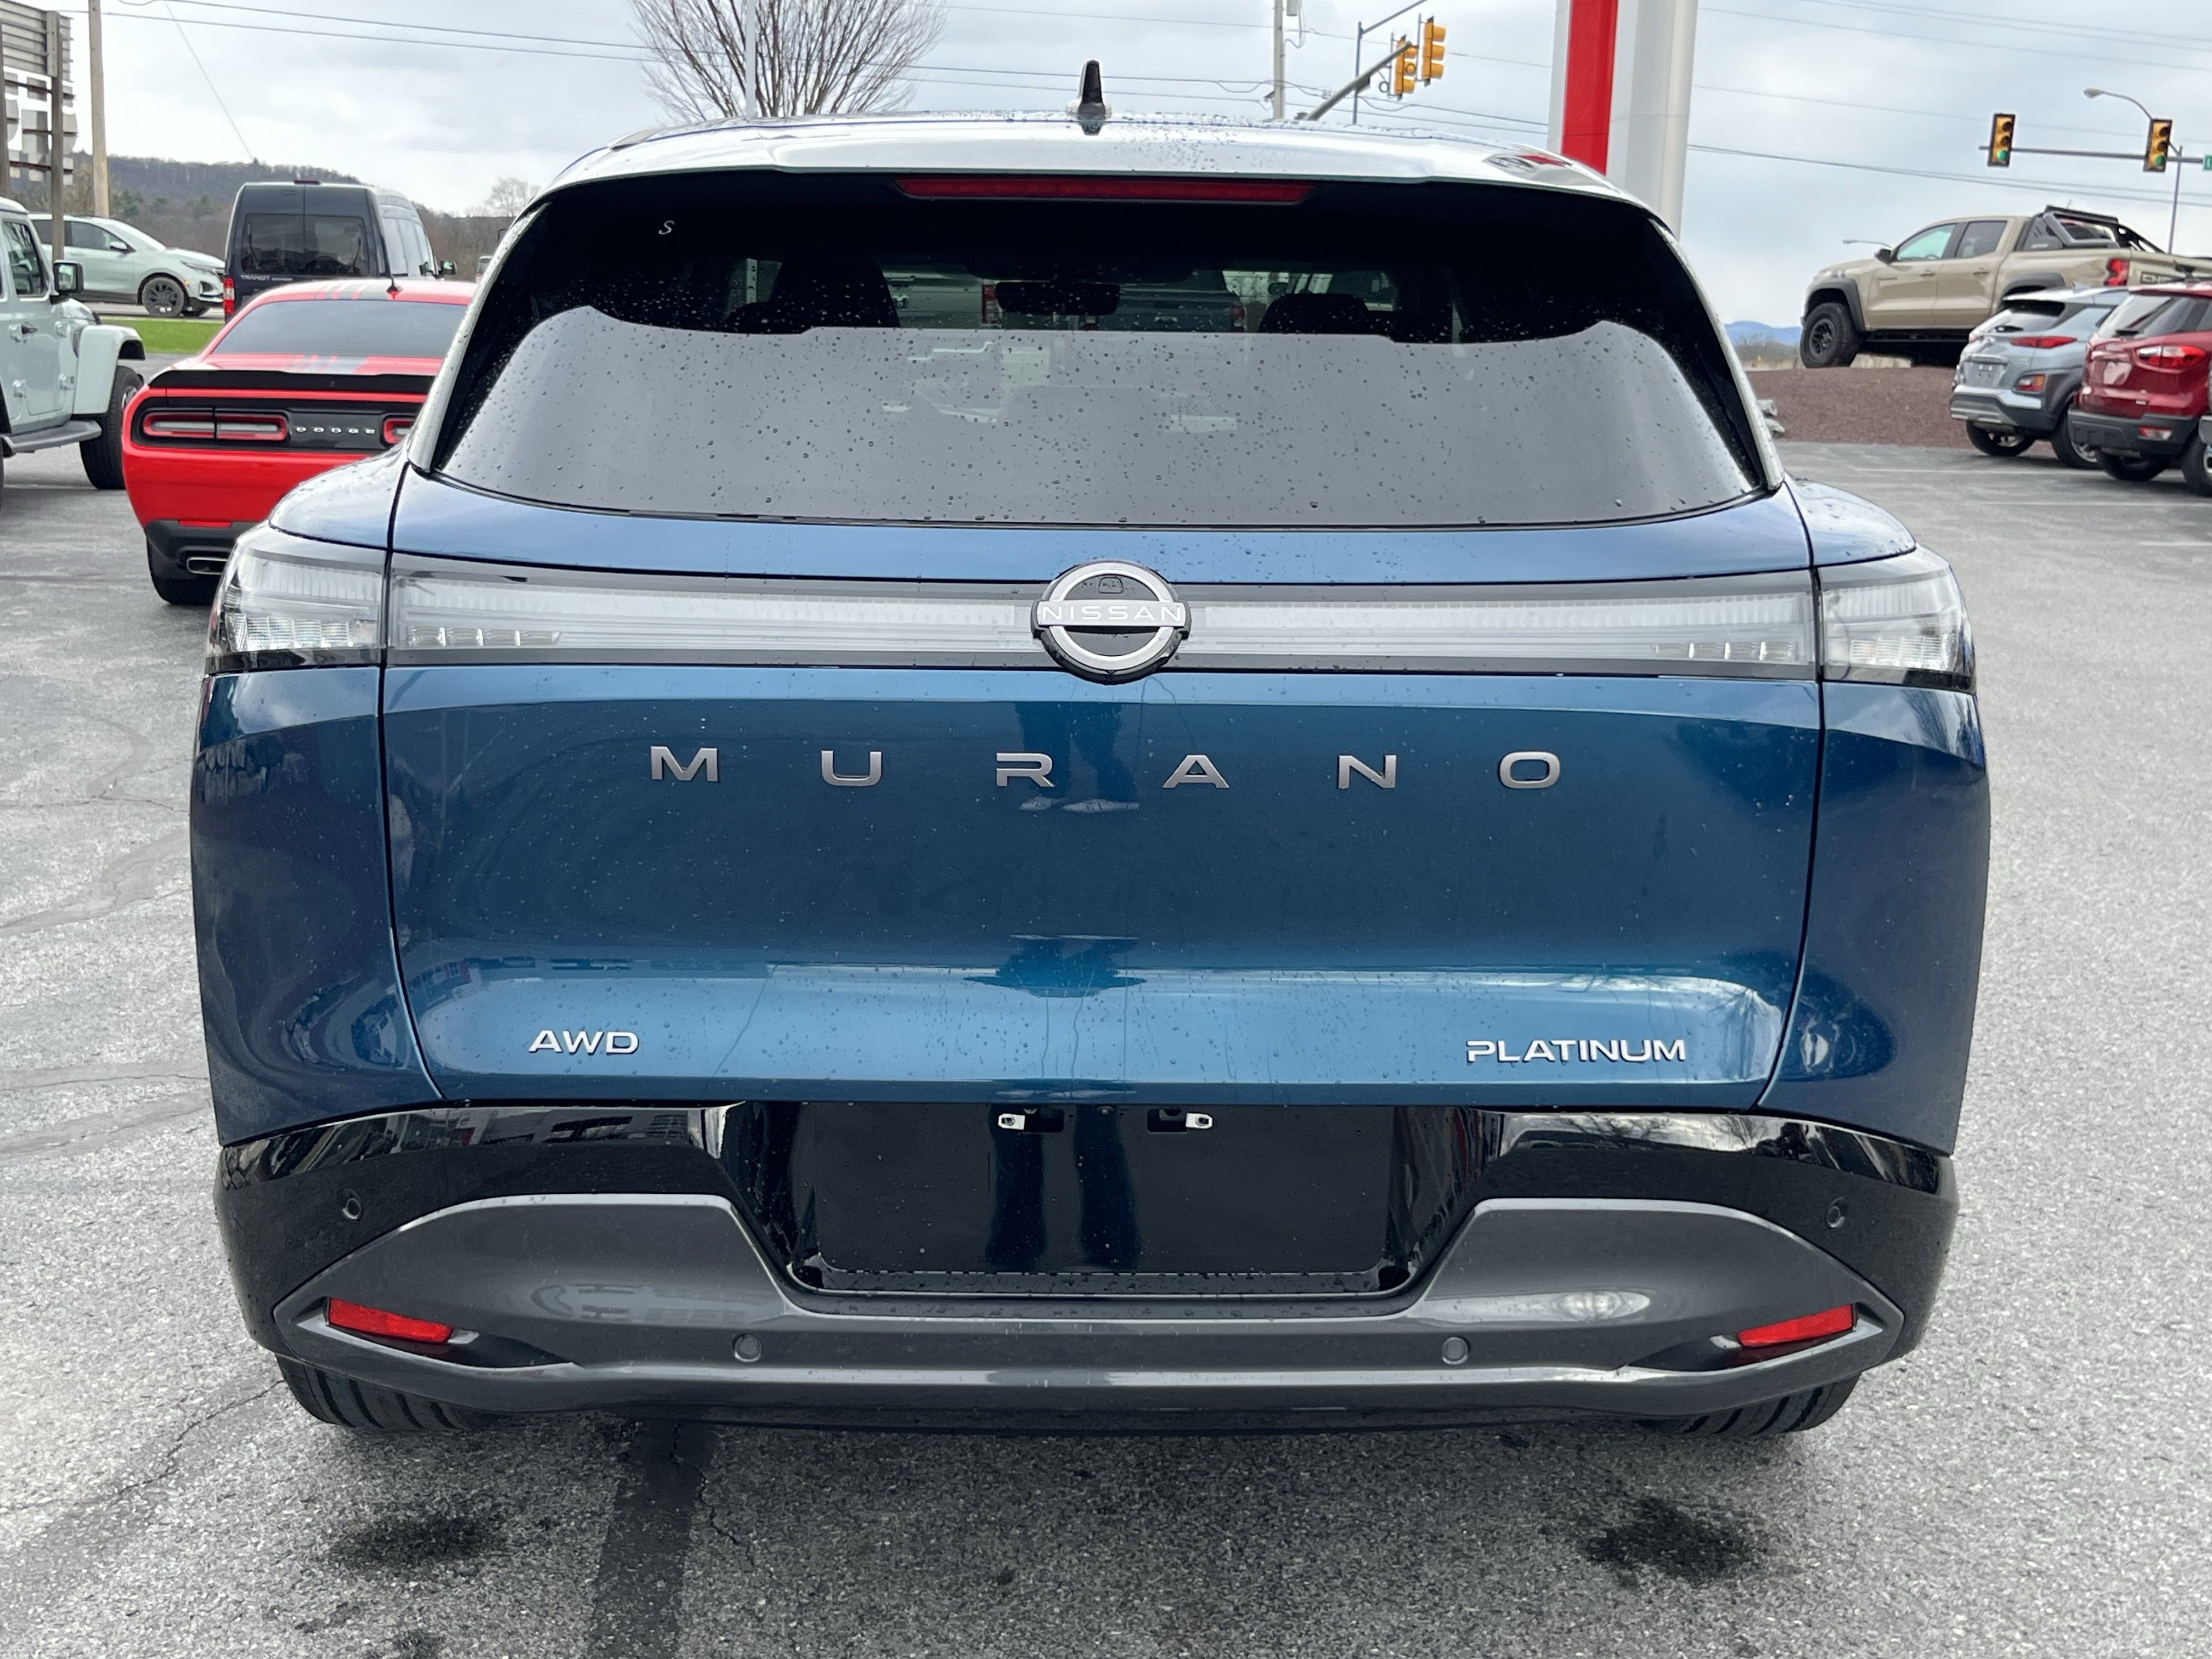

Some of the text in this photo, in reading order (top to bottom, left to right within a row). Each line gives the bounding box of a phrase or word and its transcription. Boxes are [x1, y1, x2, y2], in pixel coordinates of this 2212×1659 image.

[1042, 606, 1182, 622] NISSAN
[650, 745, 1561, 789] MURANO
[528, 1030, 639, 1055] AWD
[1466, 1039, 1686, 1063] PLATINUM
